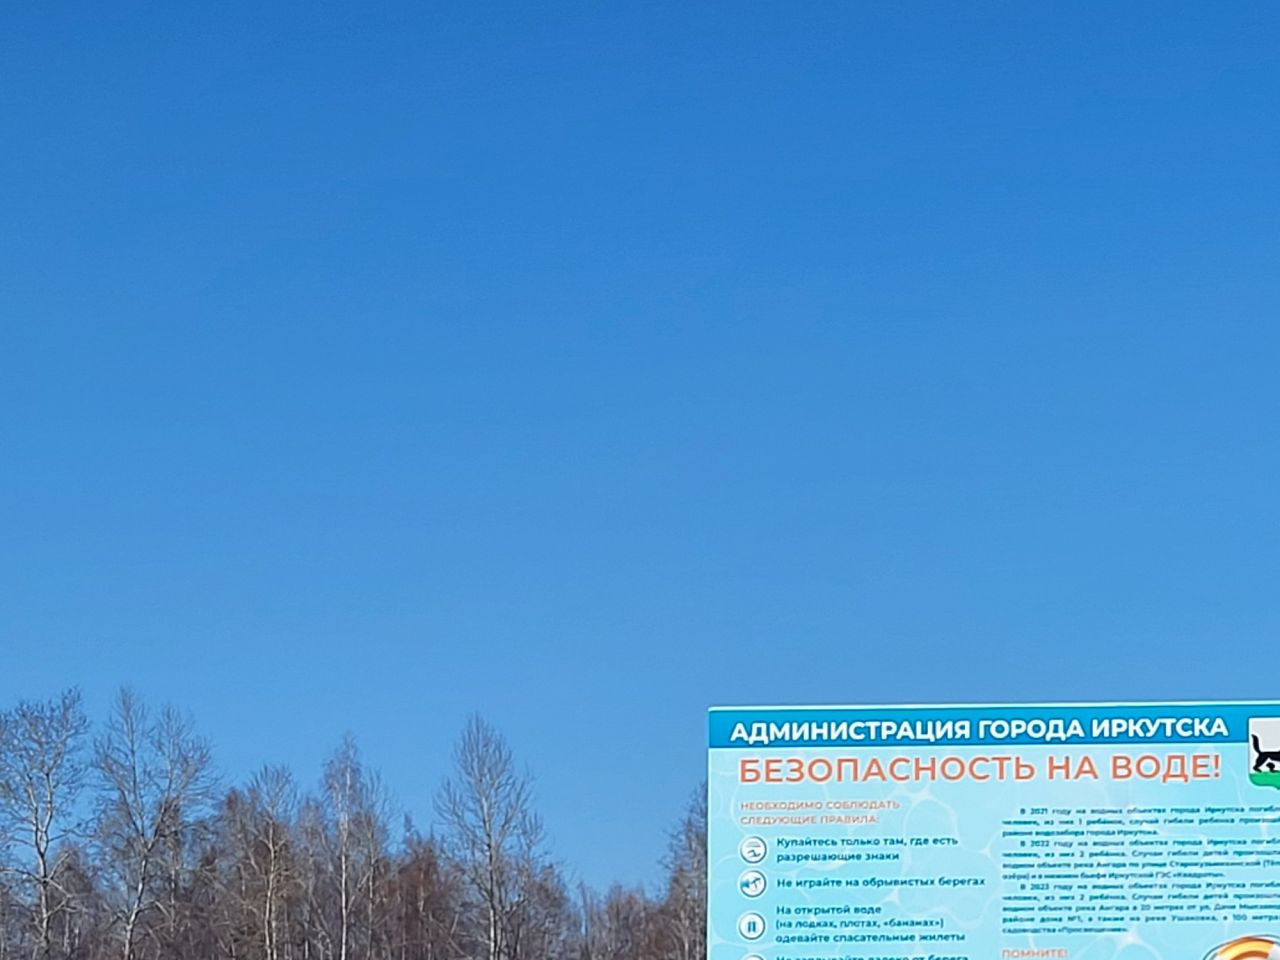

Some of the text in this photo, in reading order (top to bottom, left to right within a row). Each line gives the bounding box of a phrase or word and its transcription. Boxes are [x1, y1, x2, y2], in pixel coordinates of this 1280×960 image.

[731, 718, 1228, 744] АДМИНИСТРАЦИЯ ГОРОДА ИРКУТСКА
[741, 755, 1219, 783] БЕЗОПАСНОСТЬ НА ВОДЕ!
[740, 800, 901, 811] НЕОБХОДИМО СОБЛЮДАТЬ
[739, 815, 880, 826] СЛЕДУЮЩИЕ ПРАВИЛА:
[776, 836, 959, 849] Купайтесь только там, где есть
[776, 853, 900, 864] разрешающие знаки
[776, 876, 986, 889] Не играйте на обрывистых берегах
[775, 904, 882, 916] На открытой воде
[775, 917, 945, 930] (на лодках, плотах, «бананах»)
[775, 933, 966, 944] одевайте спасательные жилеты
